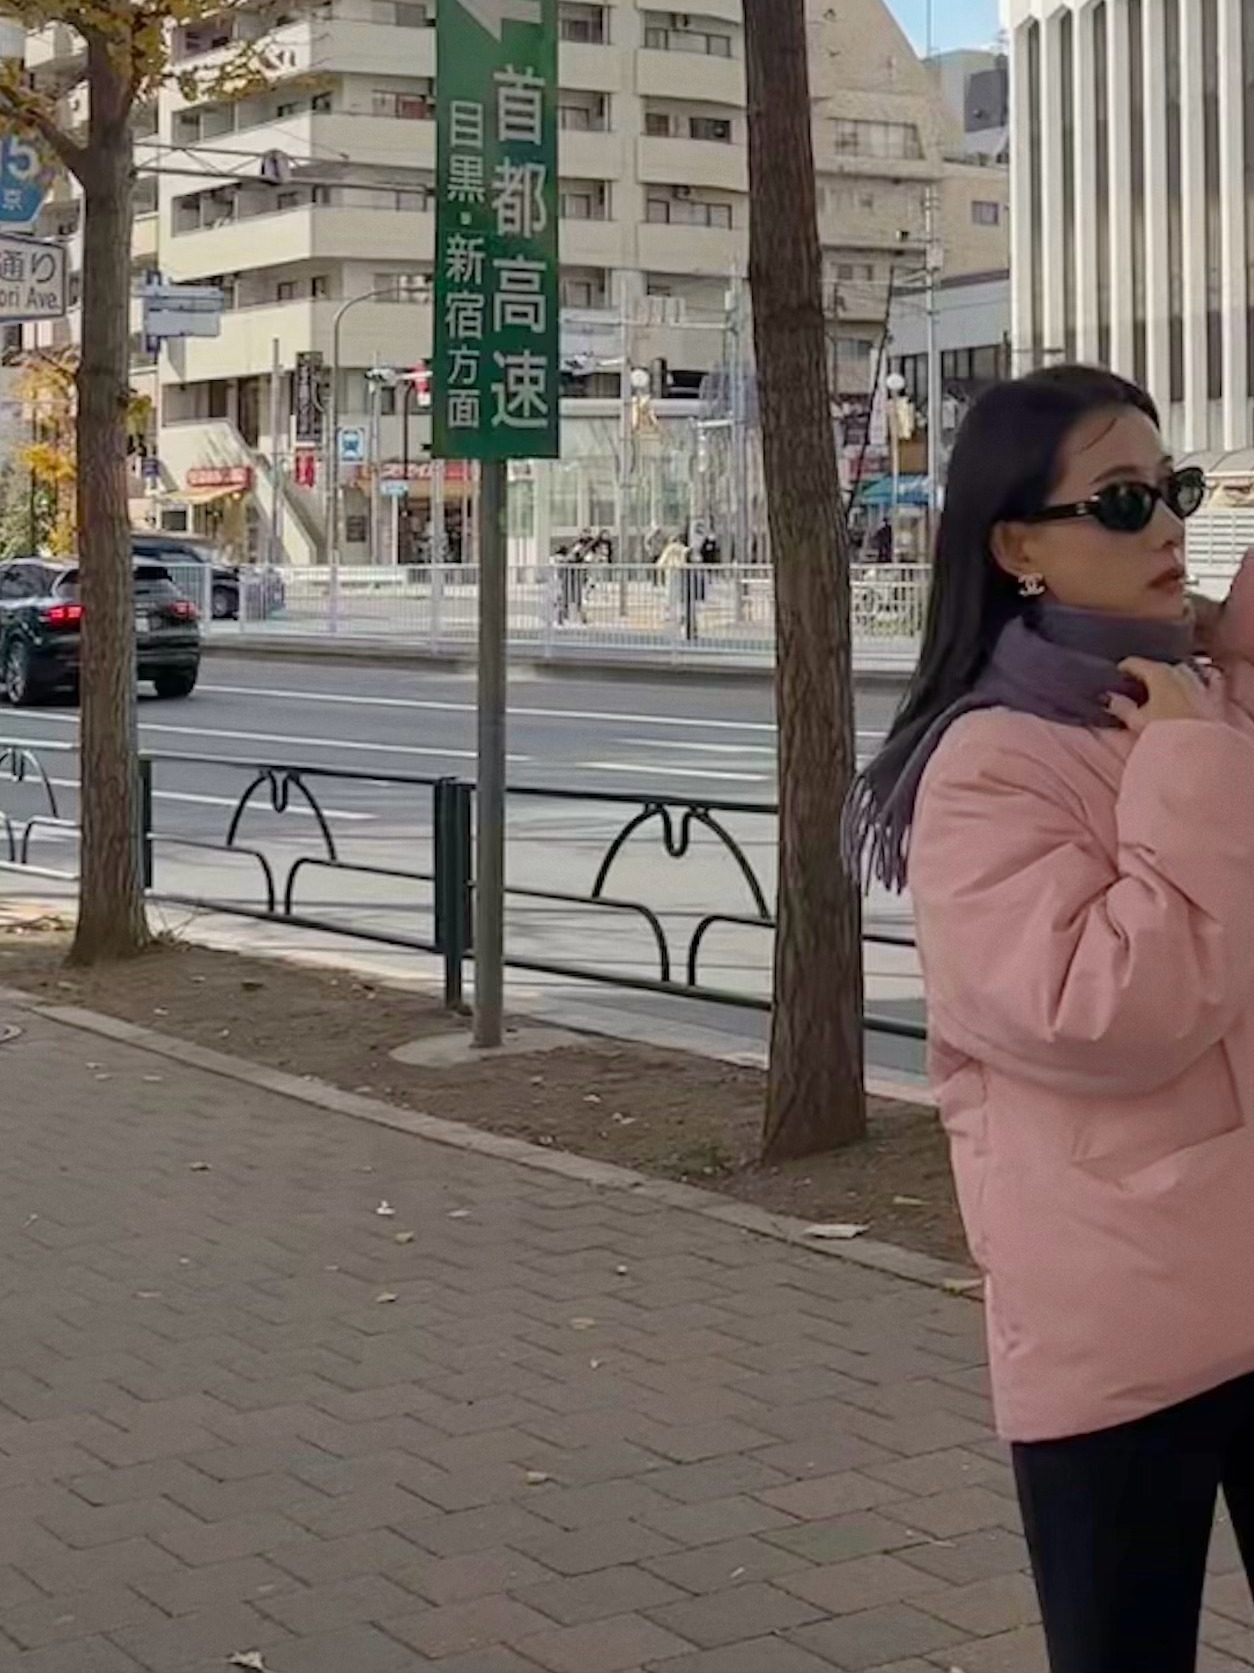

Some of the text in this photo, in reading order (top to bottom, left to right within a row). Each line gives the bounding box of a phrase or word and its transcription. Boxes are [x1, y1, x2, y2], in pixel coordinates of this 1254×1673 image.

[445, 100, 486, 429] 目黒・新宿方面
[491, 63, 548, 429] 首都高速
